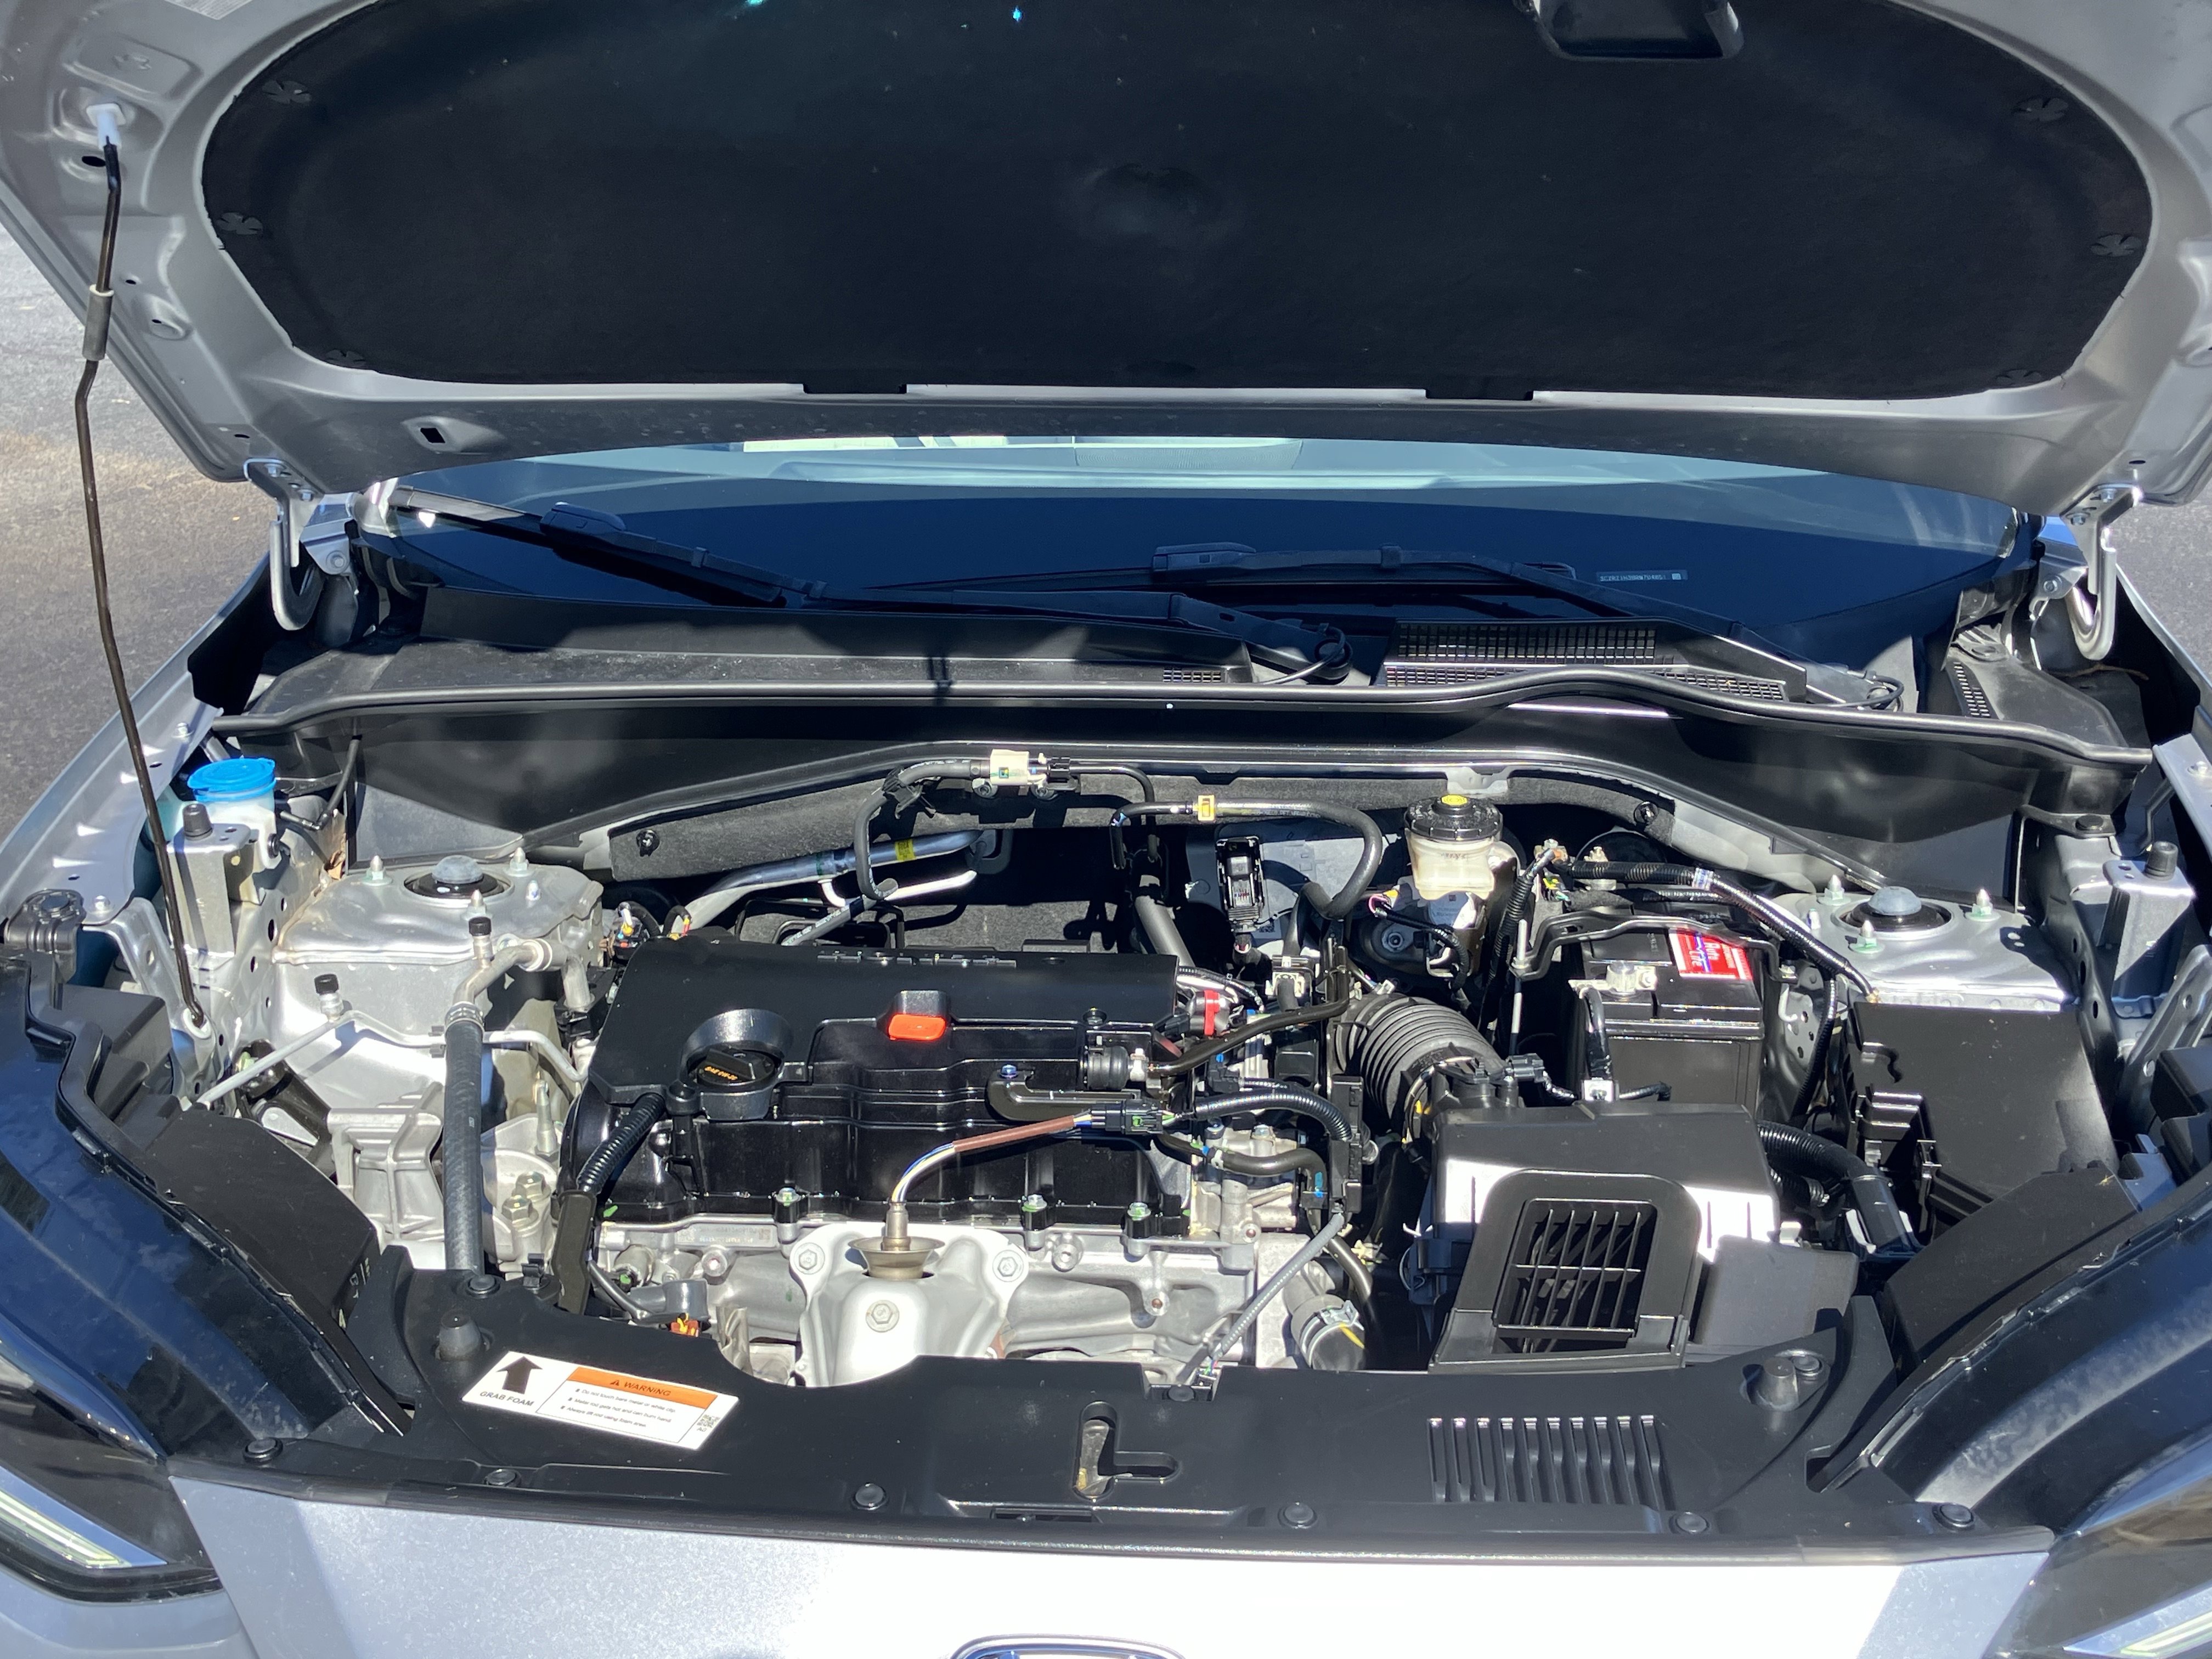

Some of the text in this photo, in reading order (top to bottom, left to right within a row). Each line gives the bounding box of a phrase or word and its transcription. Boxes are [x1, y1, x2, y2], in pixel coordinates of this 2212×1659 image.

[624, 1381, 671, 1397] WARNING
[480, 1391, 534, 1406] GRAB FOAM
